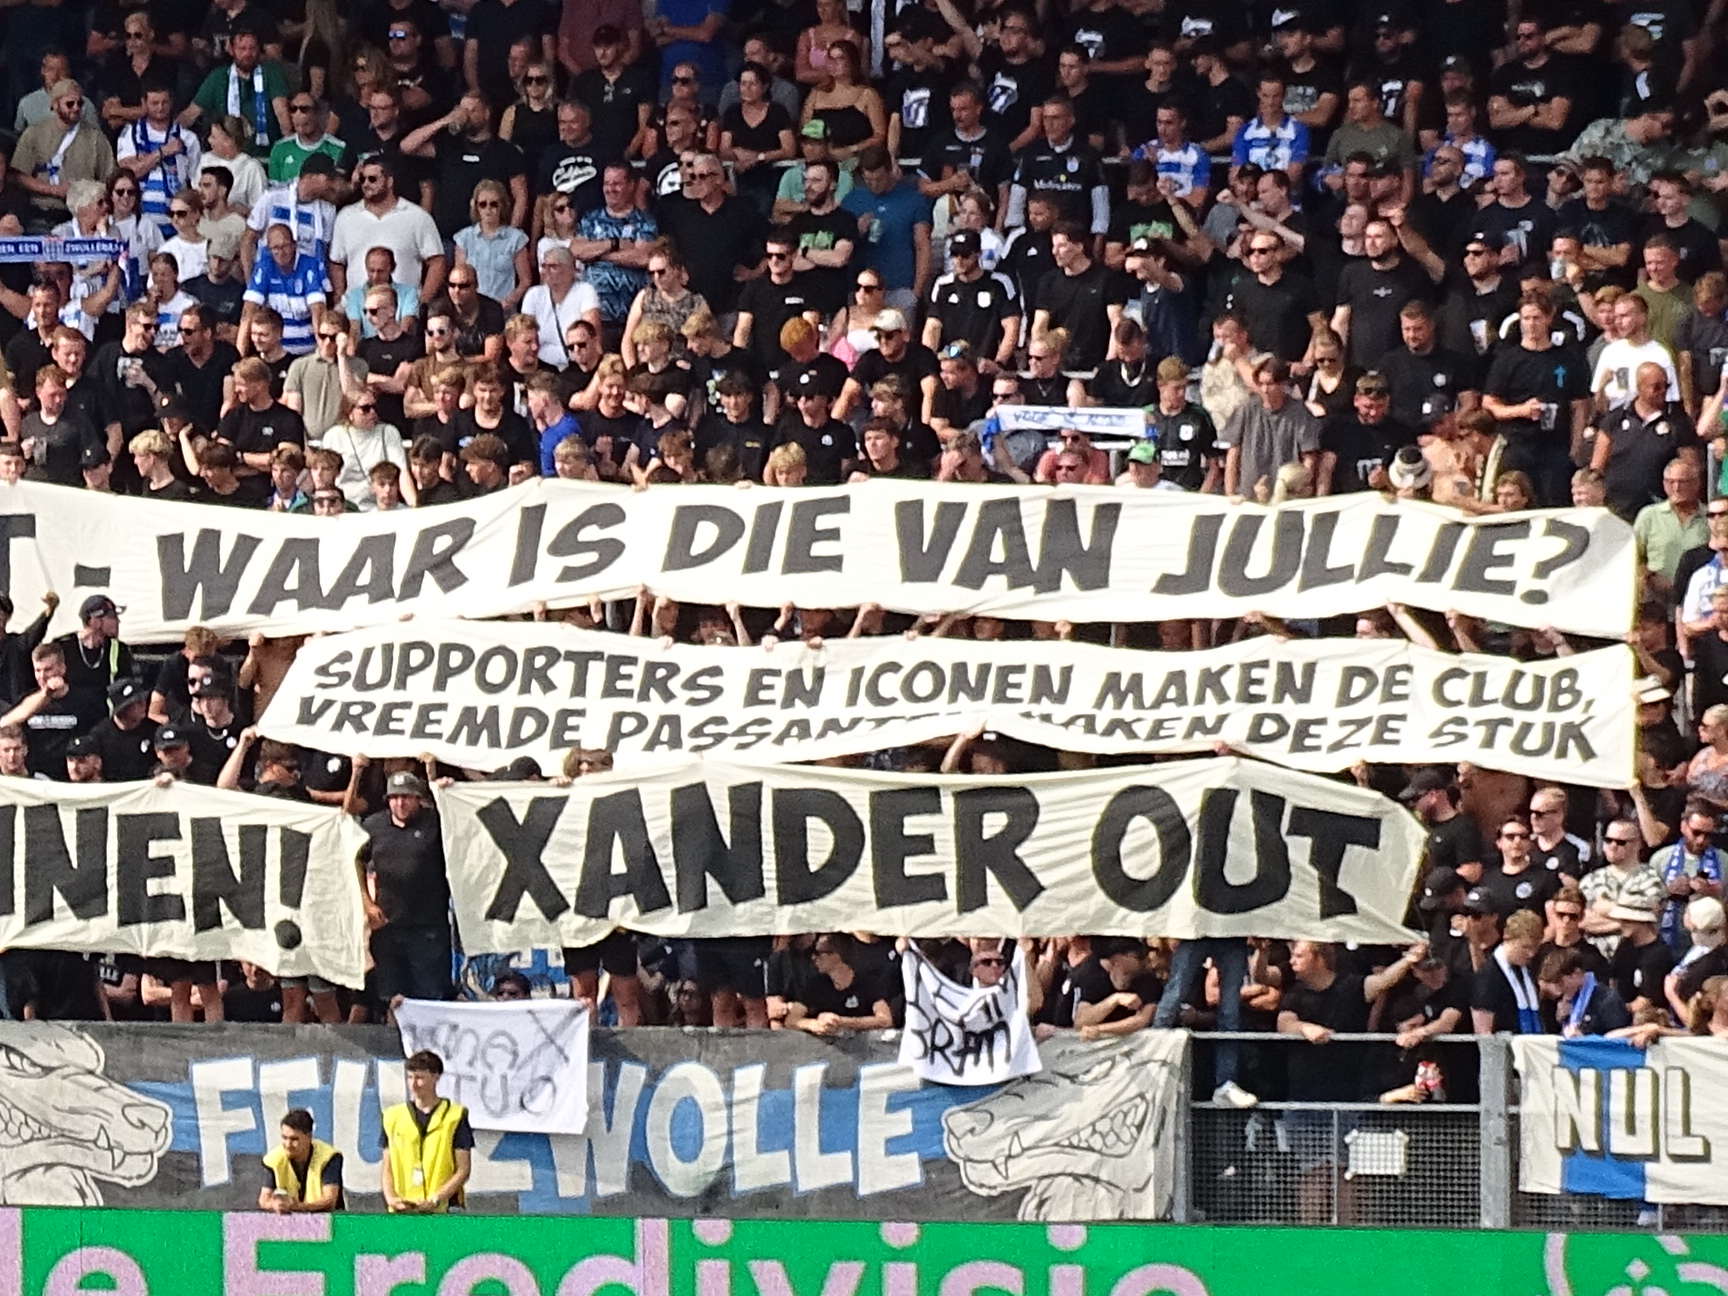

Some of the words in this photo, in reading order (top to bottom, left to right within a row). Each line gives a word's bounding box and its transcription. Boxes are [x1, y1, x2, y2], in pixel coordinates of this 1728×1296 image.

[156, 516, 475, 622] WAAR
[508, 502, 627, 588] IS
[661, 495, 851, 574] DIE
[894, 498, 1121, 594] VAN
[1152, 508, 1591, 605] JULLIE?
[314, 640, 725, 707] SUPPORTERS
[744, 665, 825, 709] EN
[844, 660, 1074, 707] ICONEN
[1092, 659, 1318, 711] MAKEN
[1336, 663, 1414, 705] DE
[1431, 665, 1597, 715] CLUB,
[296, 695, 585, 749] VREEMDE
[606, 709, 964, 753] PASSAN
[1245, 709, 1408, 754] DEZE
[1428, 714, 1599, 763] STUK
[475, 779, 1045, 924] XANDER
[1089, 786, 1382, 919] OUT
[1550, 1064, 1710, 1163] NUL
